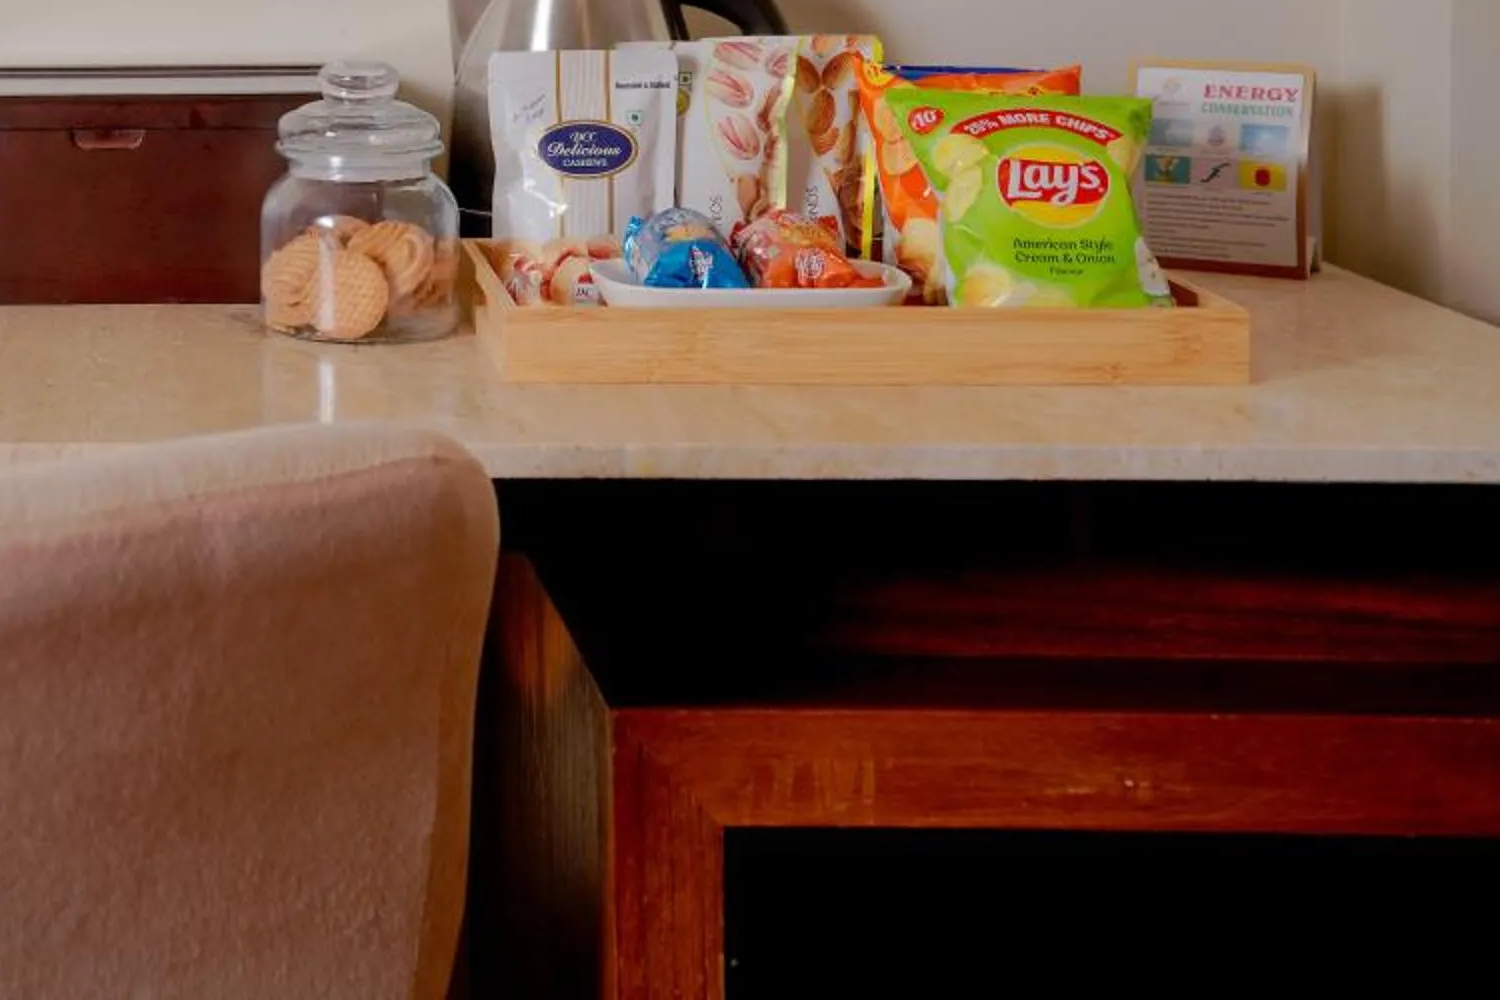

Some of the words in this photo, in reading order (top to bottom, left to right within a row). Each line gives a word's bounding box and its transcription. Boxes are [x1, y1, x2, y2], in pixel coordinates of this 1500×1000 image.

[1203, 84, 1300, 103] ENERGY
[1201, 103, 1294, 117] CONSERVATION
[998, 112, 1051, 126] MORE
[547, 141, 622, 158] Delicious
[1007, 159, 1102, 206] Lay's
[1013, 238, 1077, 250] American
[1079, 237, 1115, 253] Style
[1015, 251, 1059, 263] Cream
[1062, 253, 1073, 263] &
[1075, 252, 1116, 263] Onion
